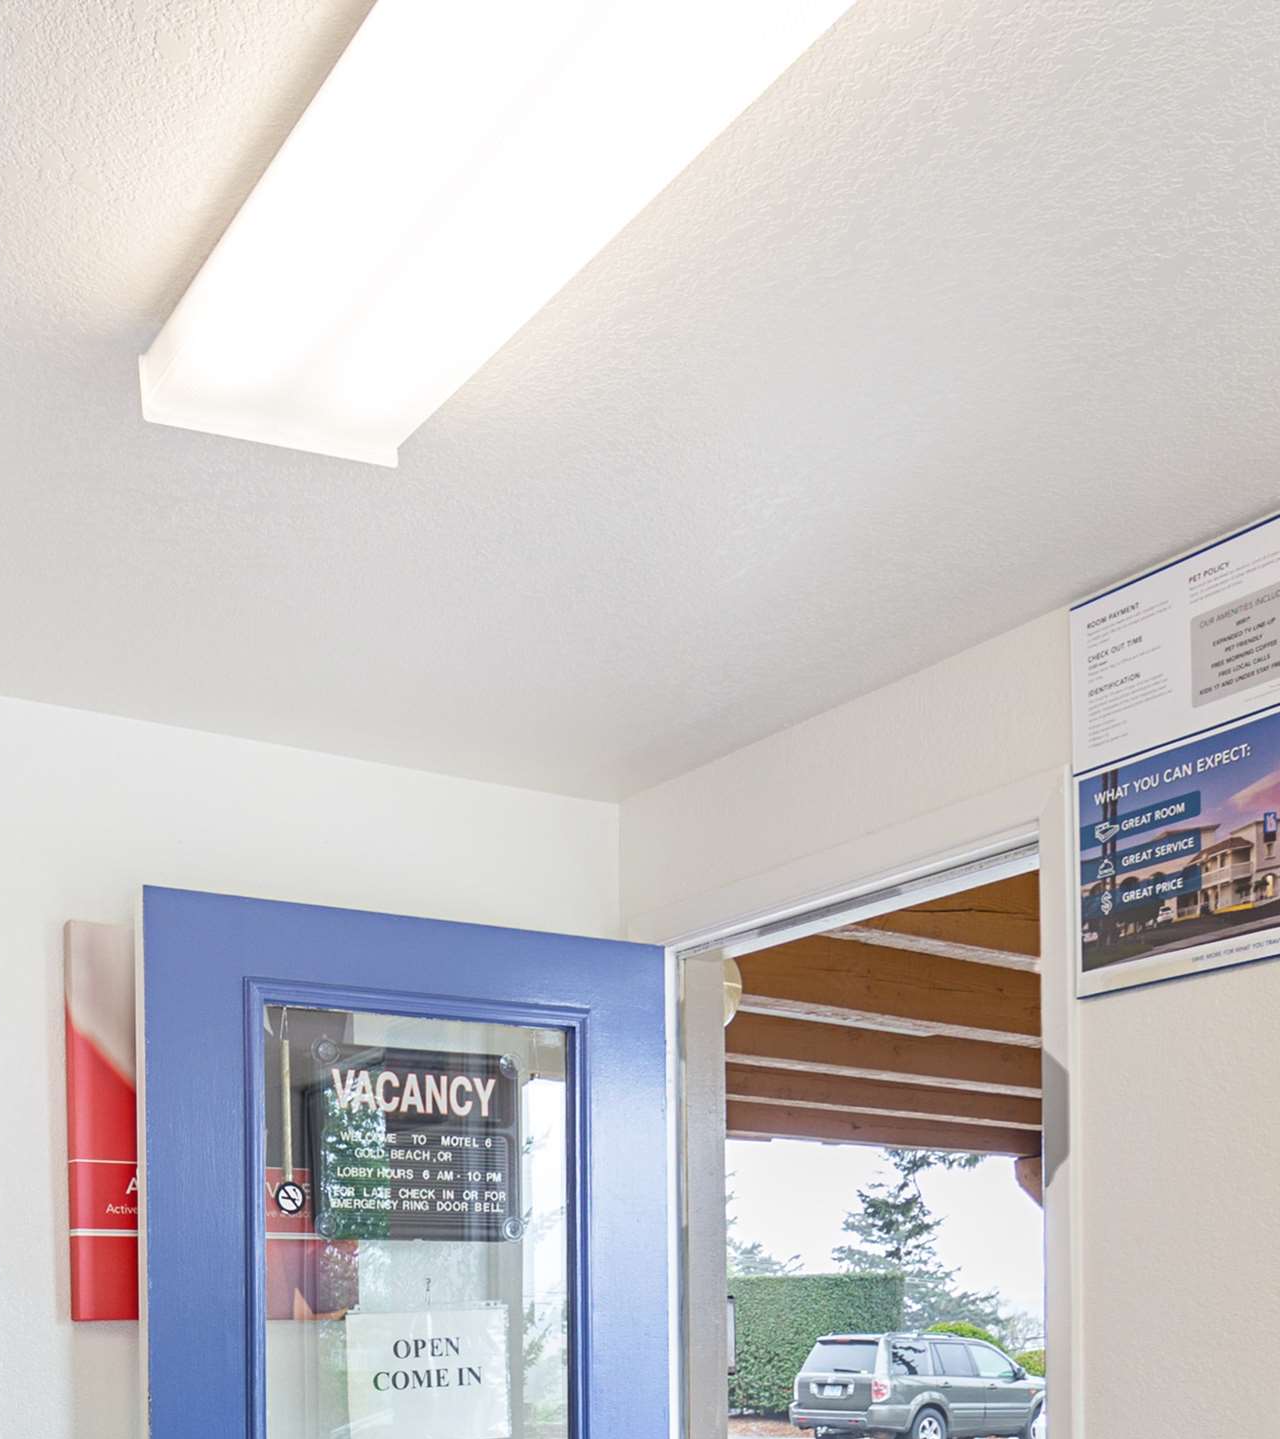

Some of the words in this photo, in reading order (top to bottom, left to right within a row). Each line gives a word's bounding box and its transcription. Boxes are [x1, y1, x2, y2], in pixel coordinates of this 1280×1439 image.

[1203, 561, 1230, 577] POLICY
[1108, 602, 1140, 620] PAYMENT
[1094, 783, 1130, 806] WHAT
[1133, 773, 1159, 793] YOU
[1163, 763, 1192, 783] CAN
[1196, 743, 1252, 773] EXPECT:
[1121, 812, 1153, 831] GREAT
[1154, 802, 1186, 821] ROOM
[1121, 848, 1153, 867] GREAT
[1154, 837, 1195, 857] SERVICE
[1122, 885, 1154, 903] GREAT
[1156, 877, 1184, 896] PRICE
[330, 1067, 497, 1117] VACANCY
[340, 1130, 397, 1144] WELCOME
[412, 1134, 427, 1146] TO
[441, 1135, 479, 1148] MOTEL
[484, 1138, 493, 1149] 6
[354, 1148, 385, 1159] GOLD
[336, 1166, 373, 1178] LOBBY
[376, 1168, 414, 1180] HOURS
[422, 1169, 430, 1180] 6
[436, 1171, 454, 1182] AM
[467, 1171, 481, 1182] 10
[486, 1172, 502, 1183] PM
[332, 1186, 355, 1198] FOR
[363, 1187, 392, 1199] LATE
[398, 1188, 436, 1200] CHECK
[442, 1190, 455, 1200] IN
[462, 1191, 479, 1200] OR
[484, 1191, 507, 1202] FOR
[329, 1198, 399, 1211] EMERGENCY
[402, 1200, 429, 1211] RING
[437, 1201, 469, 1212] DOOR
[393, 1336, 461, 1360] OPEN
[372, 1368, 449, 1391] COME
[458, 1366, 483, 1387] IN
